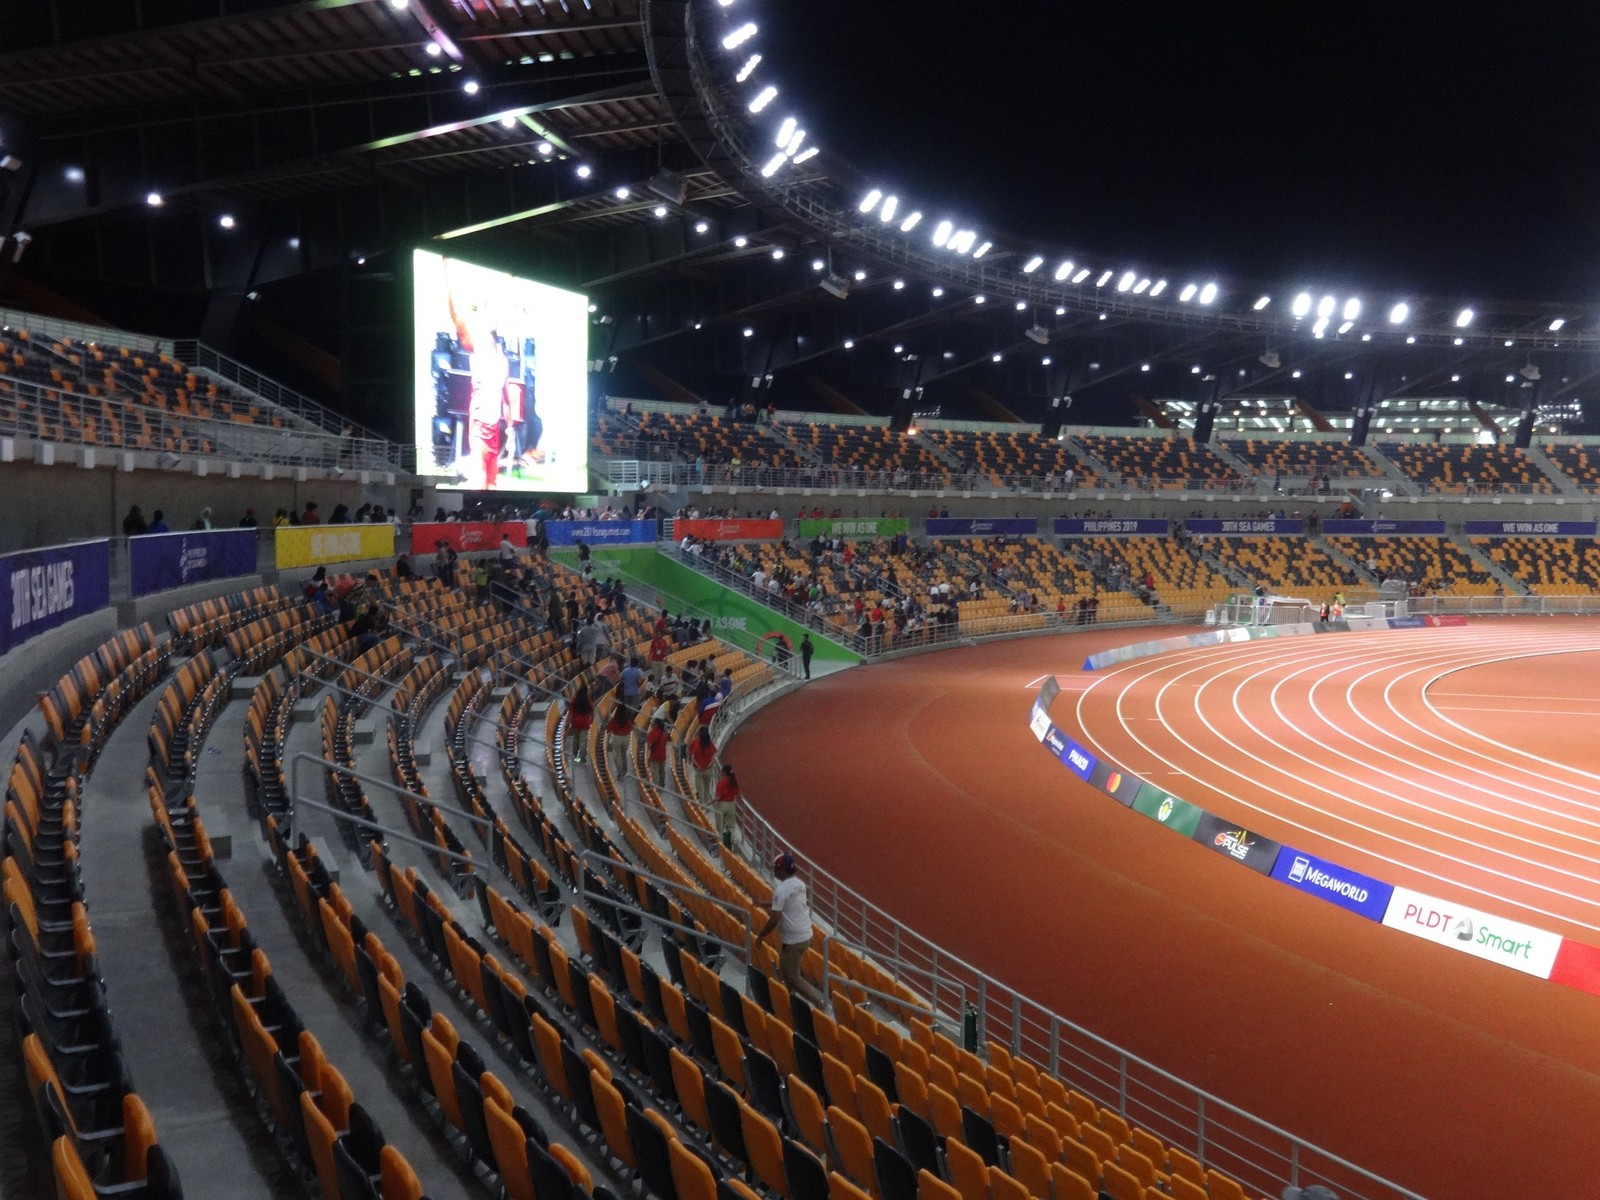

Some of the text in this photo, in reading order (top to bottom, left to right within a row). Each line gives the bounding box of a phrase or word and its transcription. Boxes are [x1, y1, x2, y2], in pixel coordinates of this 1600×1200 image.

[832, 522, 842, 534] WE
[856, 522, 865, 534] AS
[866, 522, 877, 534] ONE
[1083, 521, 1138, 531] PHILIPPINES 2019
[1221, 521, 1275, 531] 30TH SEA GAMES
[1502, 522, 1559, 533] WE WIN AS ONE
[31, 565, 47, 621] SEA
[47, 560, 74, 614] GAMES
[715, 616, 728, 629] AS
[728, 617, 747, 630] ONE
[1222, 839, 1249, 857] PULSE
[1305, 867, 1368, 903] MEGAWORLD
[1404, 903, 1532, 959] PLDT Smart
